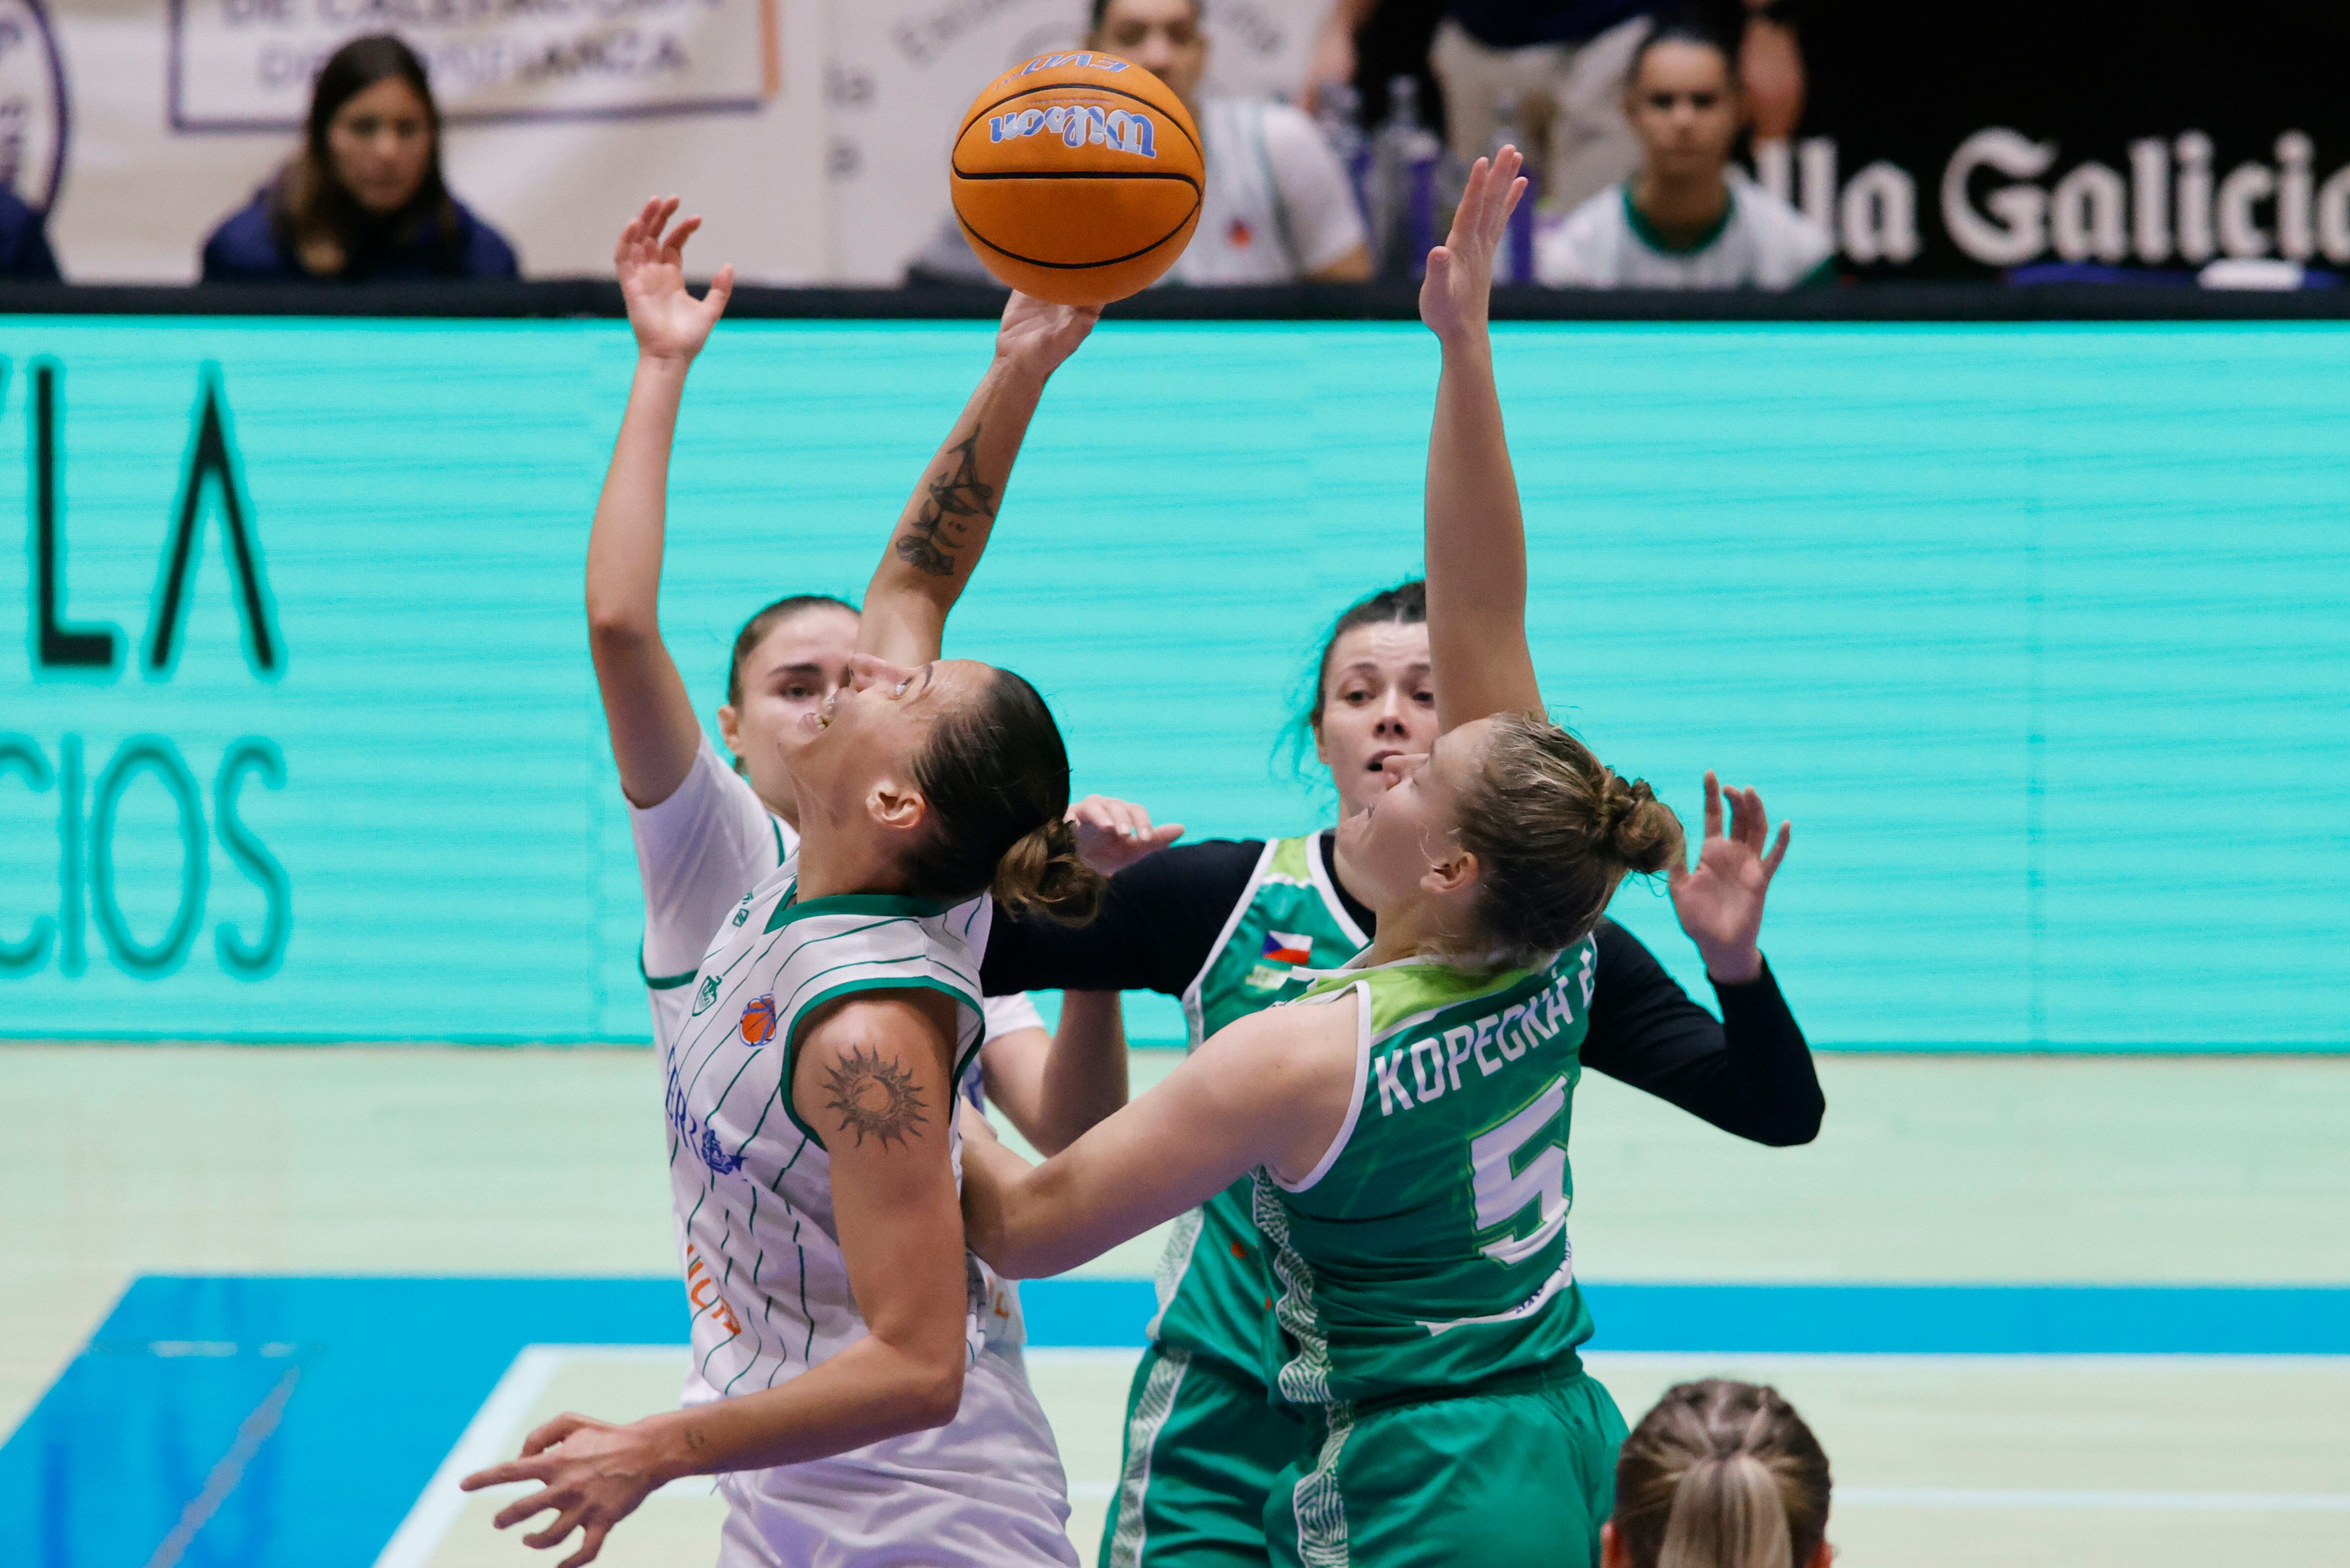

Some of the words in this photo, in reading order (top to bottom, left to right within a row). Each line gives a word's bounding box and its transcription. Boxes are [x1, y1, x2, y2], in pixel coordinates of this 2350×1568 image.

[989, 105, 1157, 158] Wilson
[0, 364, 275, 671] LA
[1374, 966, 1574, 1116] KOPECKÁ
[1467, 1071, 1572, 1269] 5
